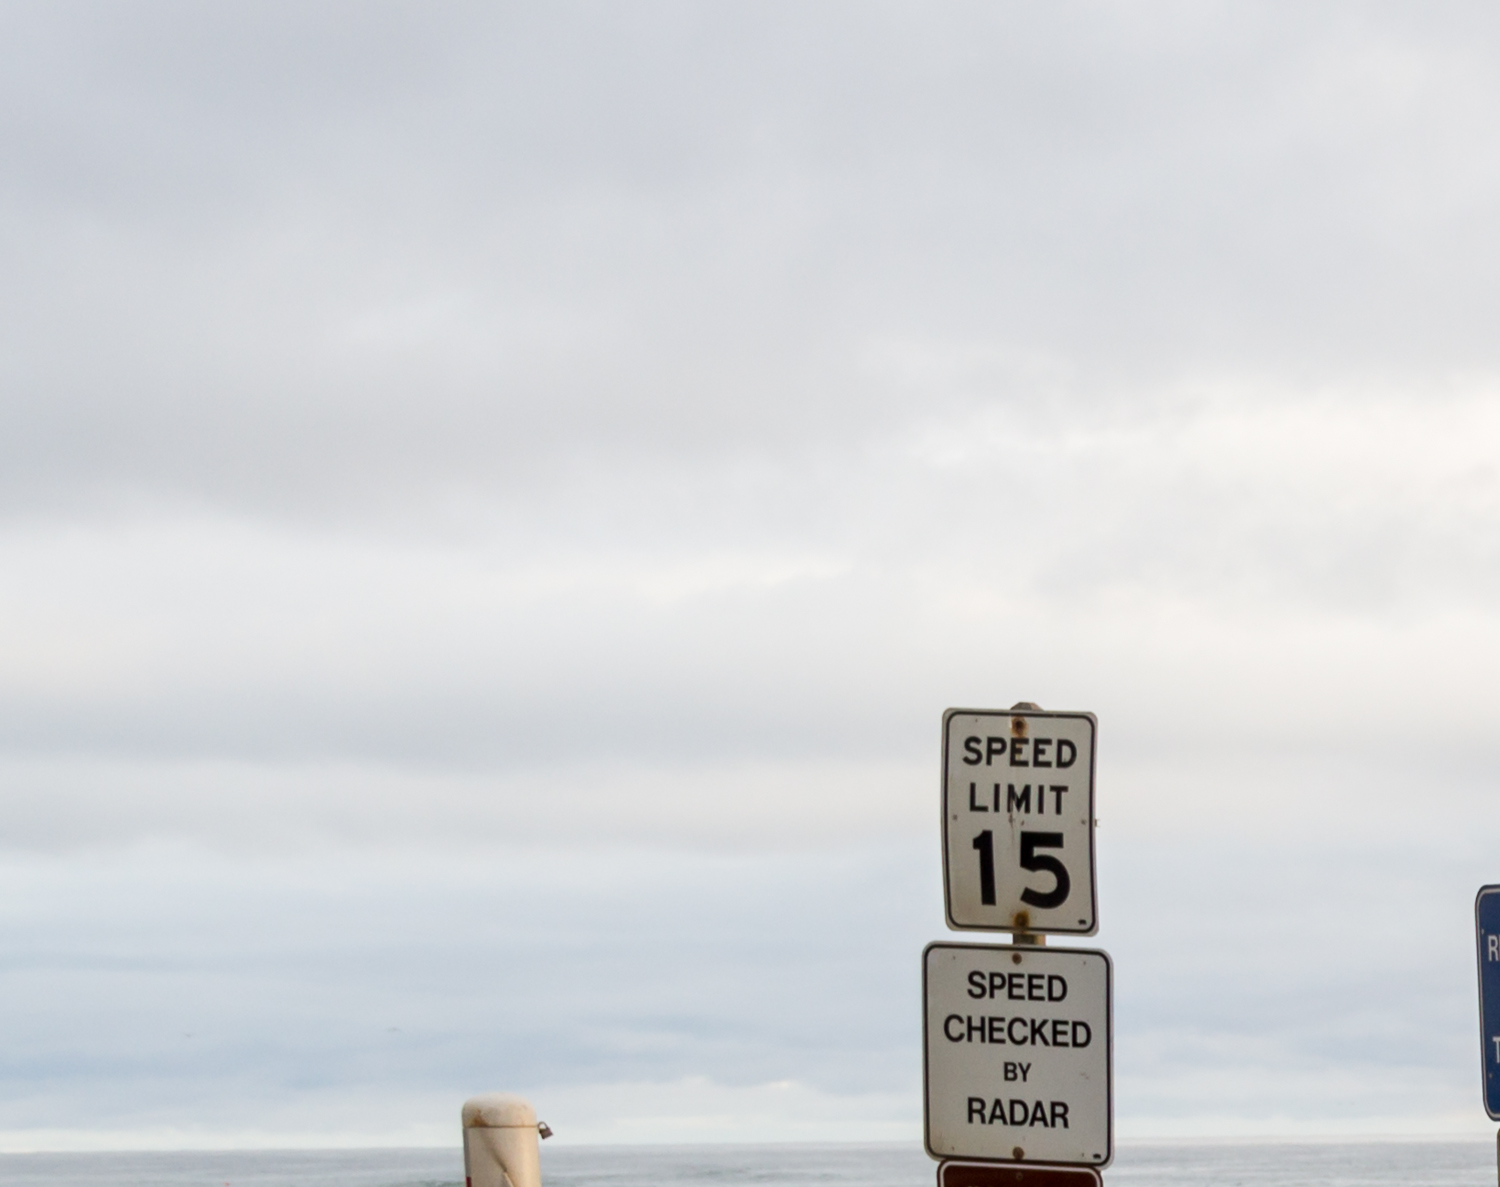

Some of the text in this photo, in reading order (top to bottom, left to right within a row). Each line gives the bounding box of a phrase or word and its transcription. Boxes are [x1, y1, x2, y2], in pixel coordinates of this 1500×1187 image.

[962, 736, 1078, 768] SPEED
[970, 782, 1068, 815] LIMIT
[972, 830, 1070, 908] 15
[967, 971, 1068, 1002] SPEED
[944, 1015, 1091, 1047] CHECKED
[1003, 1062, 1031, 1082] BY
[967, 1097, 1069, 1128] RADAR
